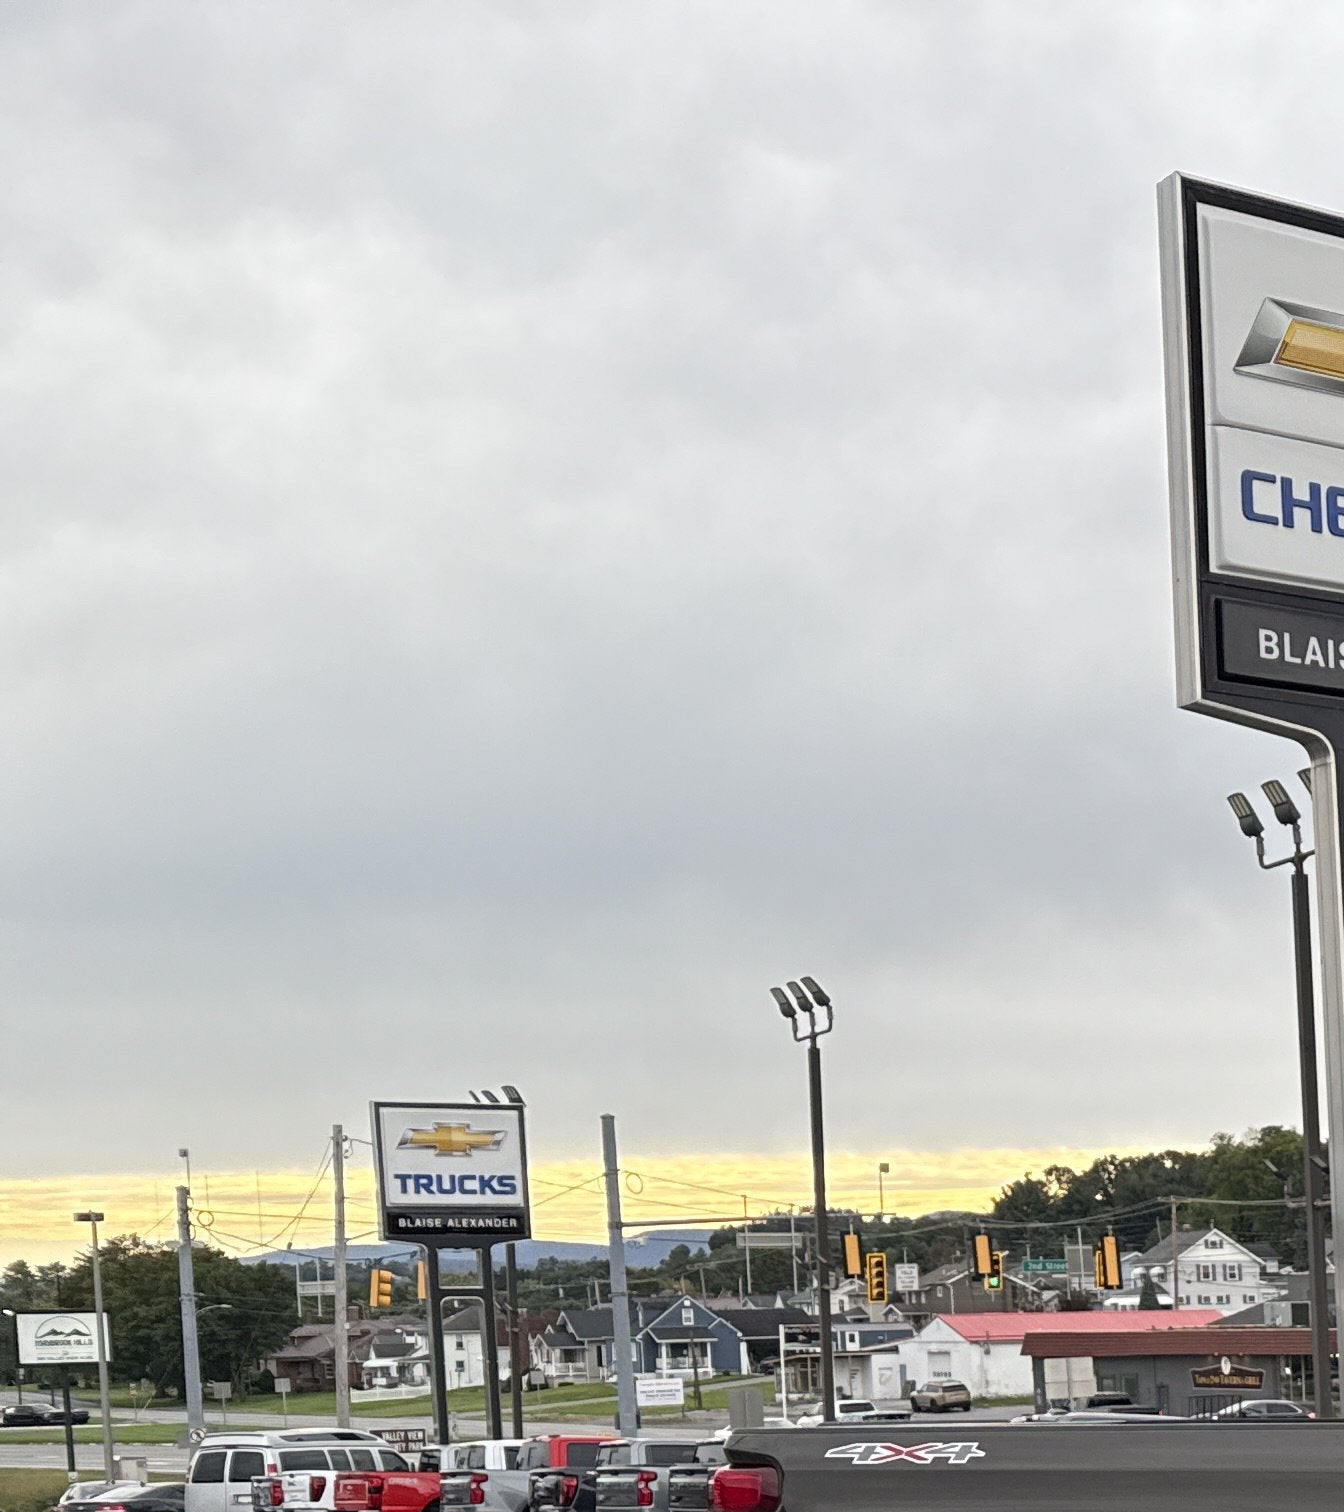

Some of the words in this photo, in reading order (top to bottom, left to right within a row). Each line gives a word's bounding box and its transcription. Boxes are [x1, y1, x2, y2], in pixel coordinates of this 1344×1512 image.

[393, 1173, 517, 1195] TRUCKS
[398, 1218, 442, 1227] BLAISE
[447, 1218, 518, 1227] ALEXANDER
[1028, 1262, 1042, 1270] 2nd
[1045, 1262, 1068, 1270] Street
[381, 1431, 405, 1441] VALLEY
[407, 1430, 424, 1440] VIEW
[824, 1442, 986, 1464] 4X4
